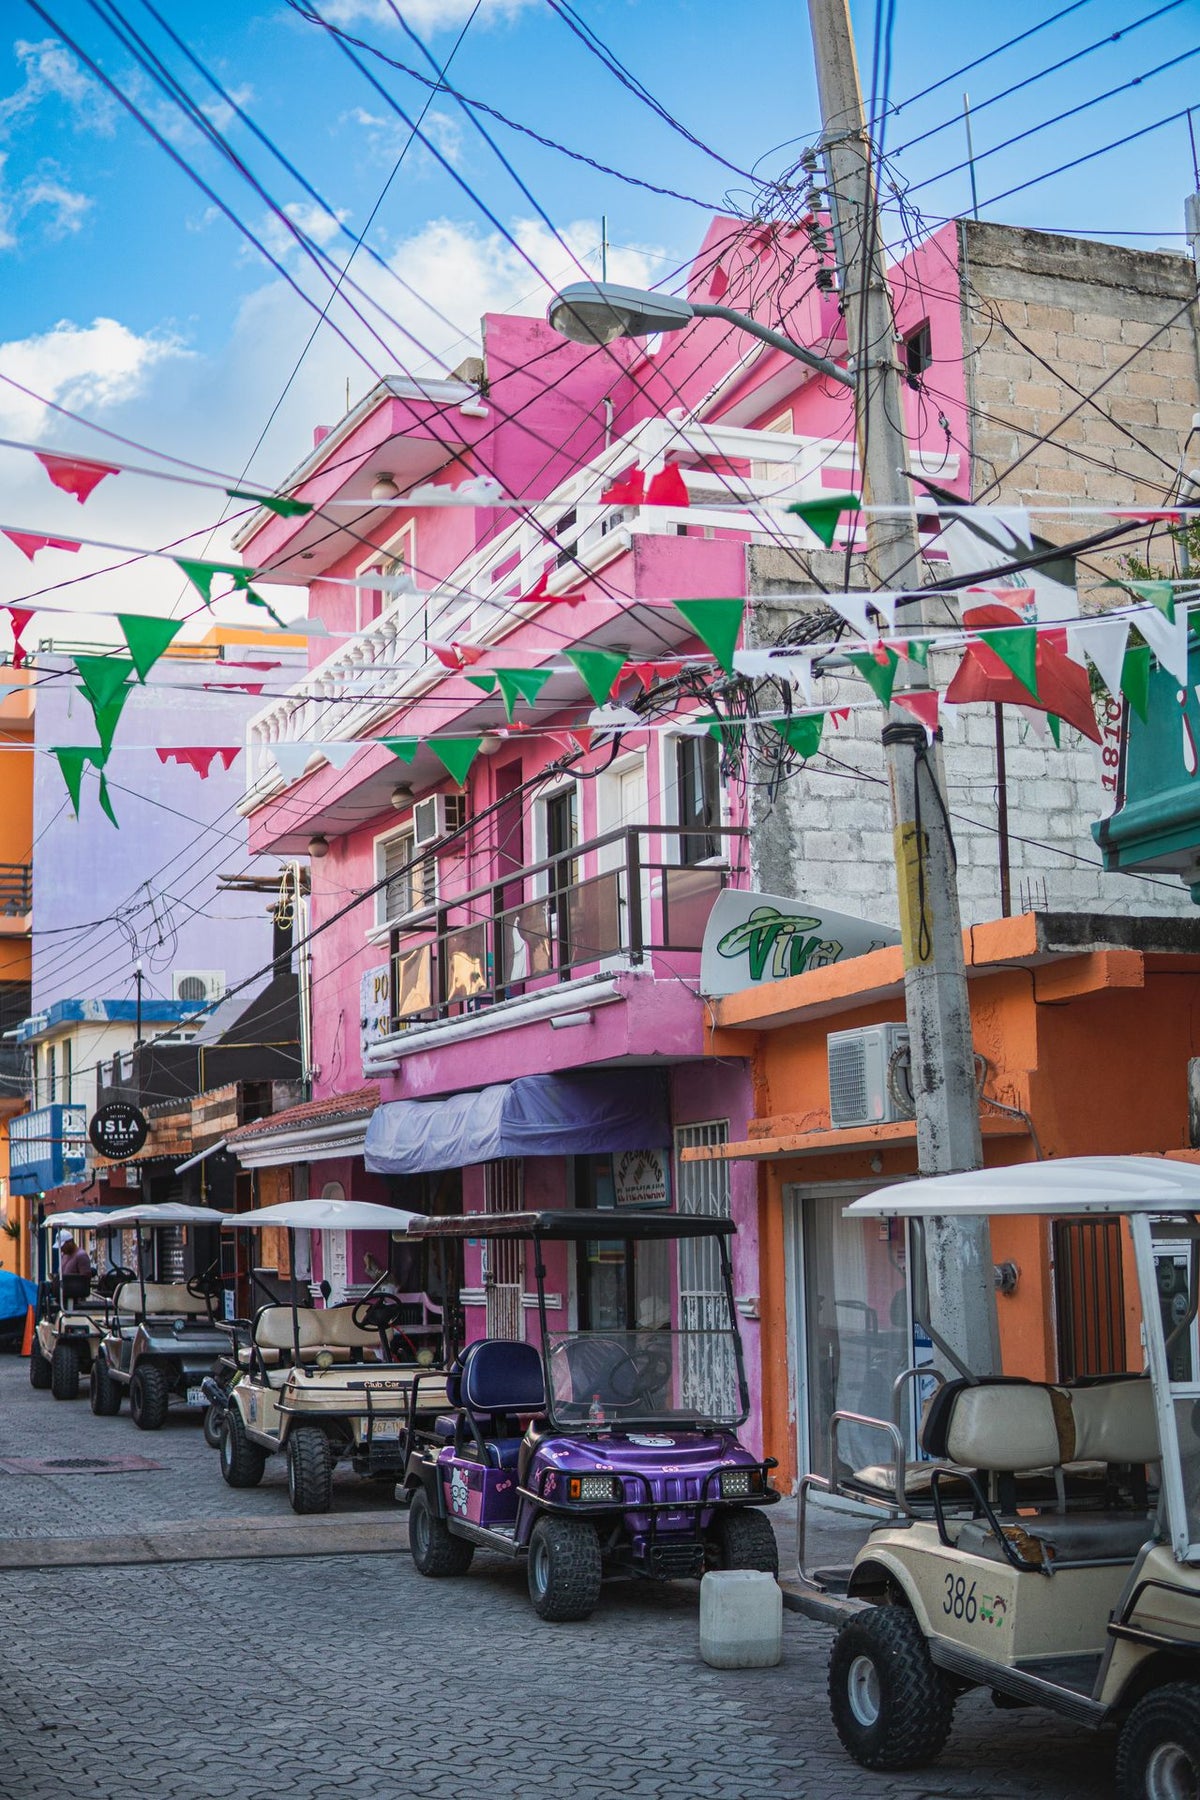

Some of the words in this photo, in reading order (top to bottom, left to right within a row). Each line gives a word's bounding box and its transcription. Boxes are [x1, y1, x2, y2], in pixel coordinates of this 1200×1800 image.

[1101, 697, 1122, 792] 1810
[749, 922, 843, 980] Viva
[97, 1120, 139, 1133] ISLA
[943, 1573, 977, 1624] 386
